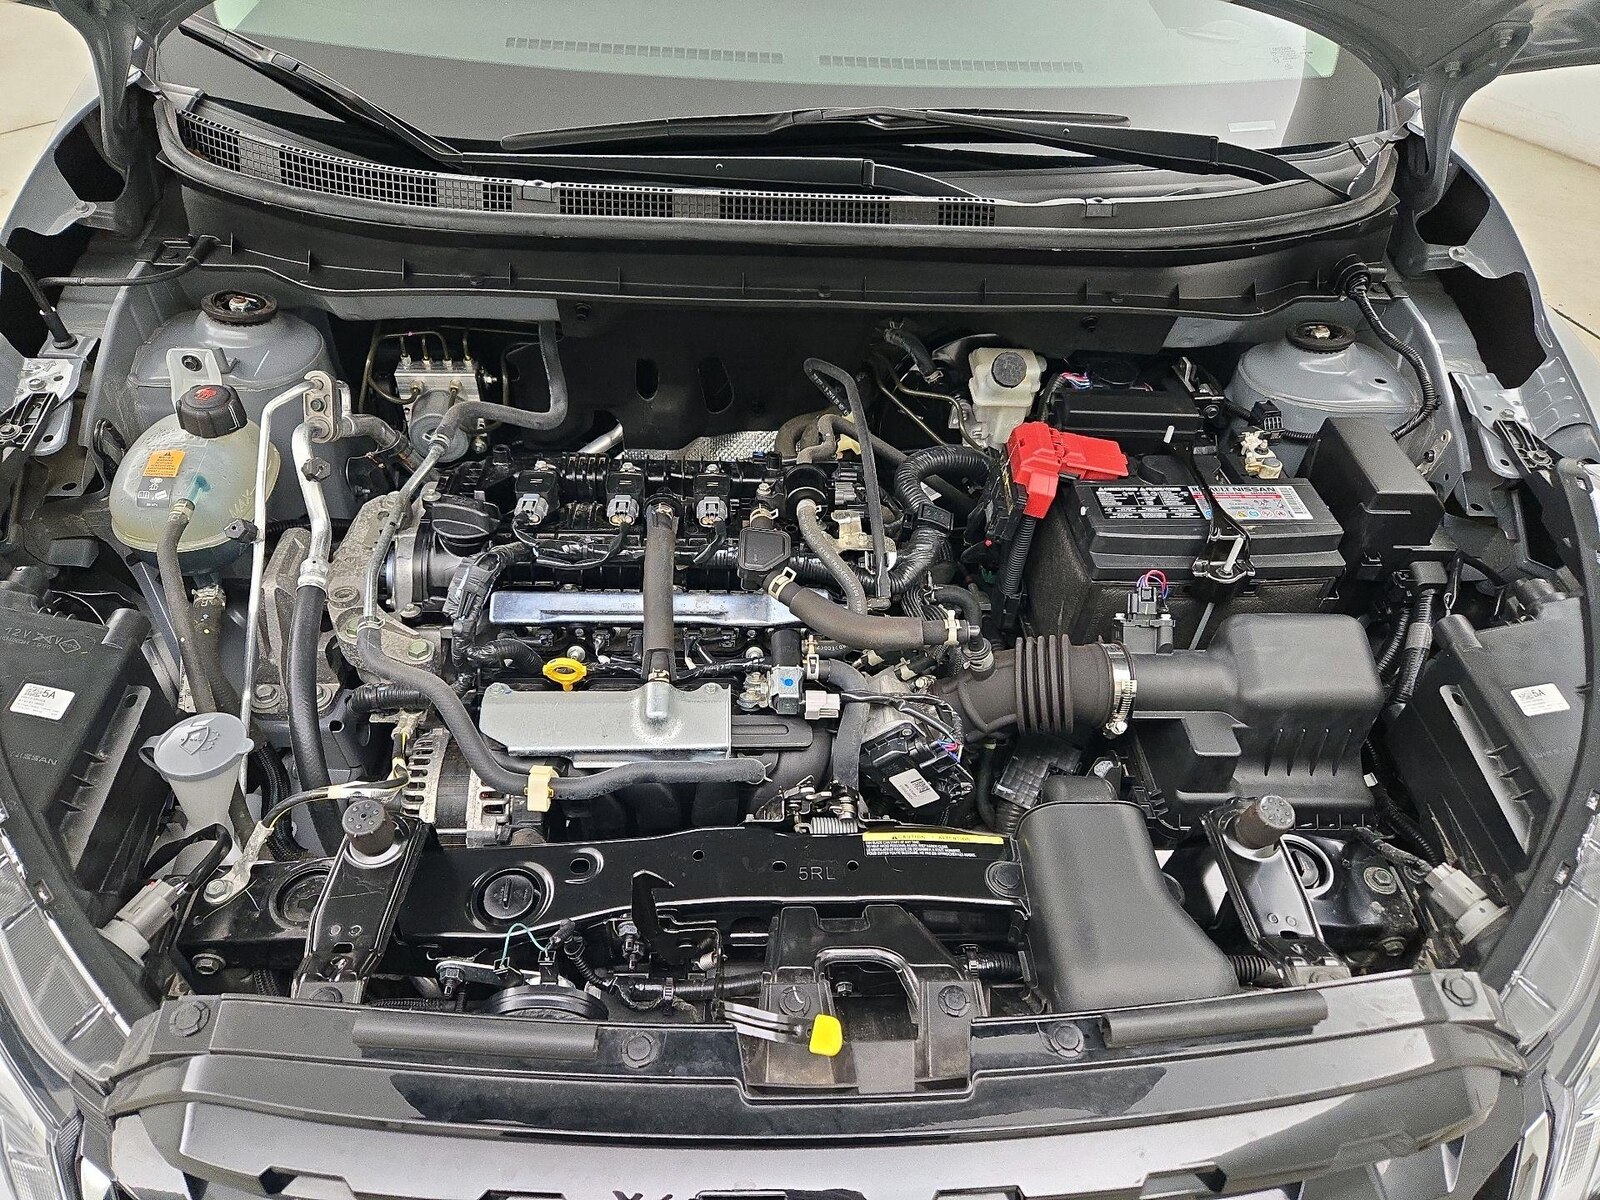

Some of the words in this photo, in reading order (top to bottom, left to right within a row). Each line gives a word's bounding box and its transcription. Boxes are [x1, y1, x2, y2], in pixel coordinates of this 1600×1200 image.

[41, 690, 56, 700] 5A
[1531, 688, 1546, 698] 5A
[799, 866, 836, 880] 5RL
